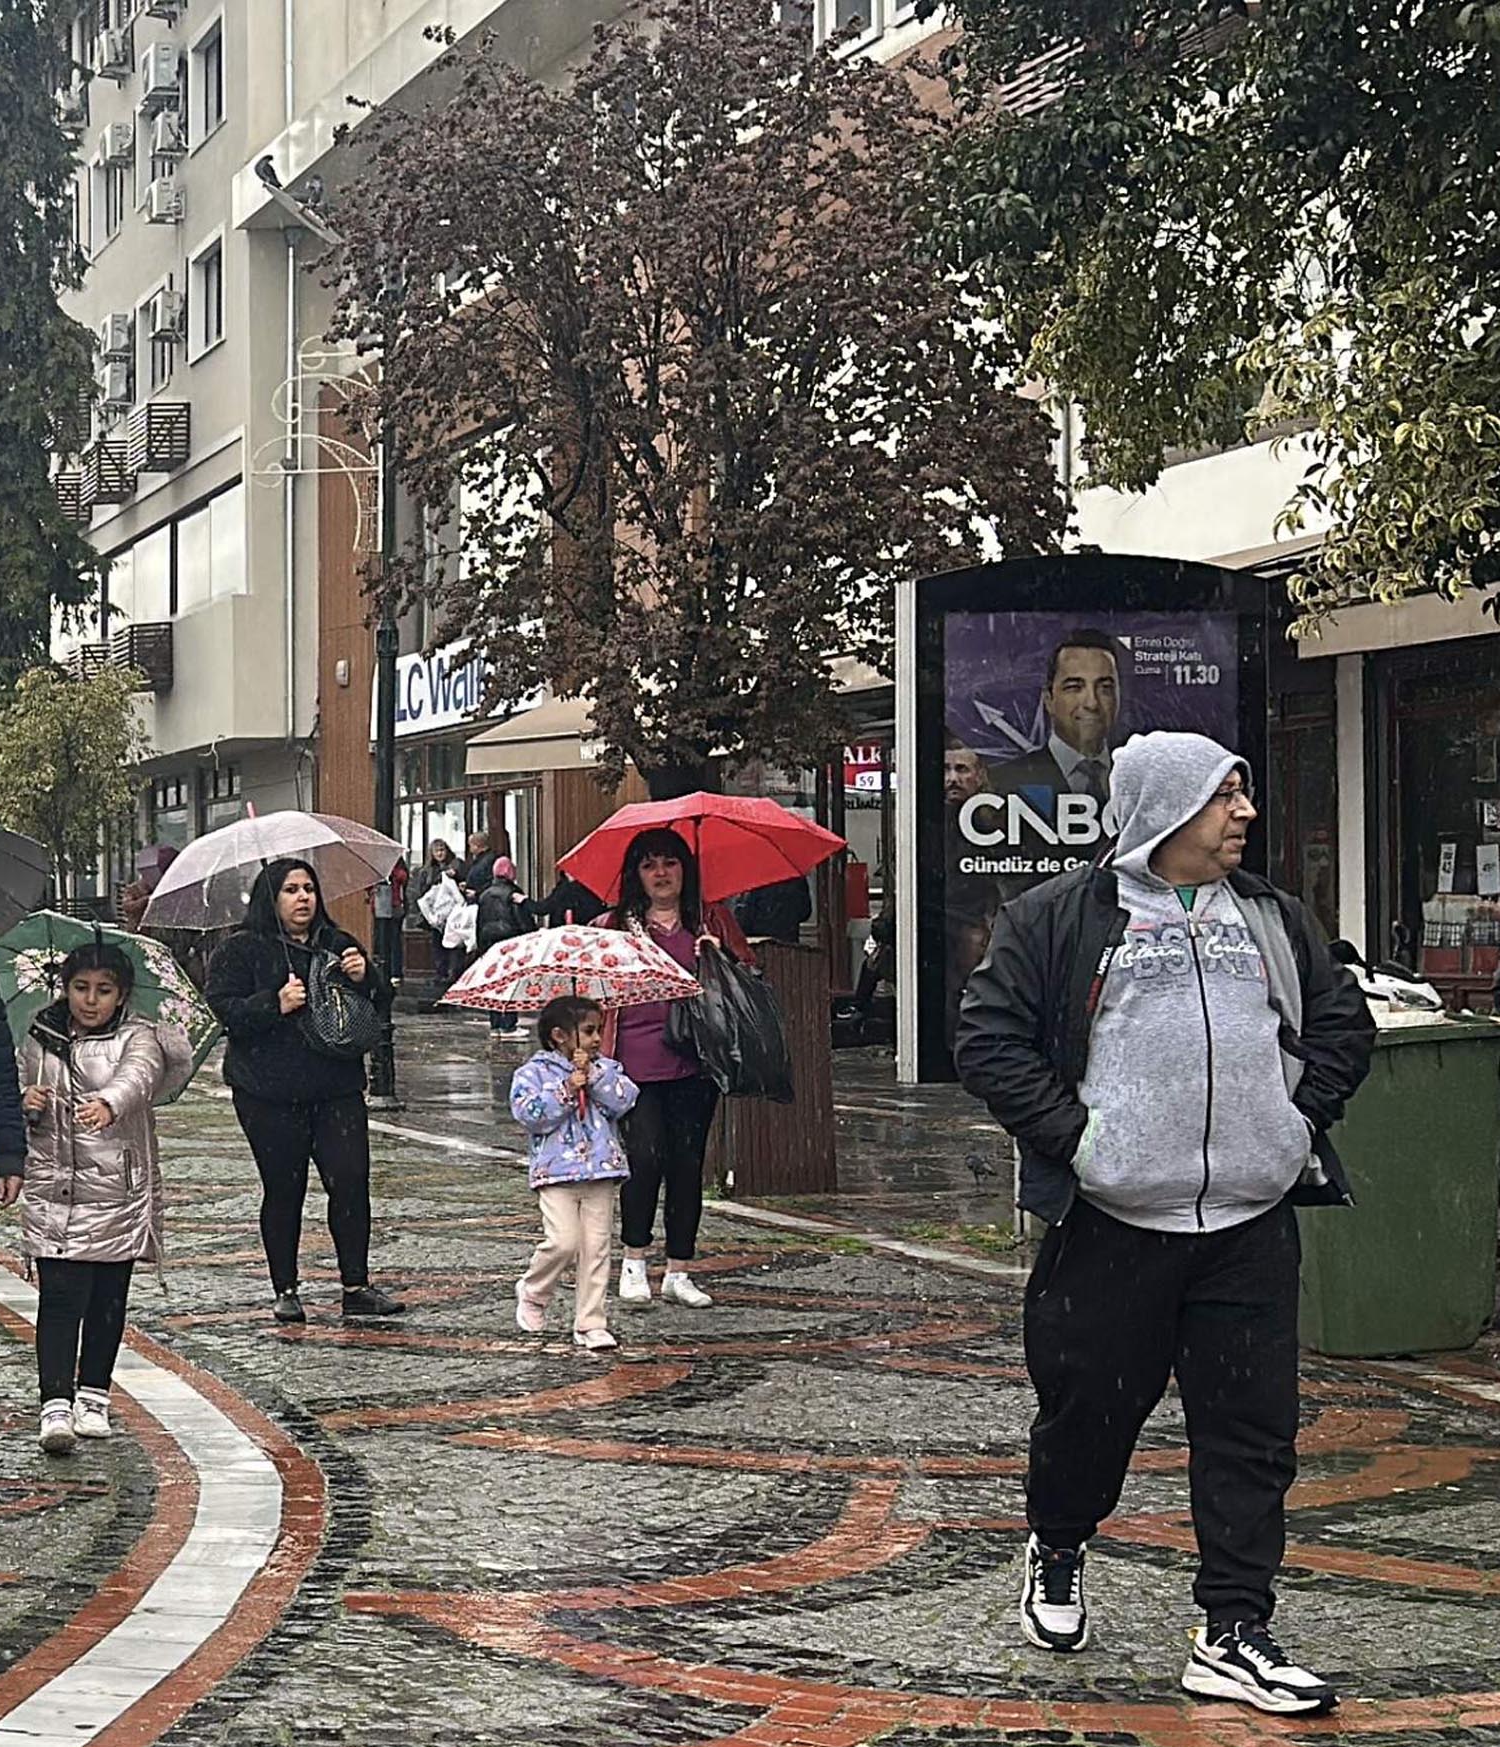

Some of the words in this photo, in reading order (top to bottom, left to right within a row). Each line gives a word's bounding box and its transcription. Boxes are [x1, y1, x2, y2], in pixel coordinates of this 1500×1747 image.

[1173, 665, 1220, 685] 11.30
[395, 662, 424, 722] LC
[859, 775, 875, 787] 59
[959, 856, 1033, 874] Gündüz
[1036, 857, 1061, 873] de
